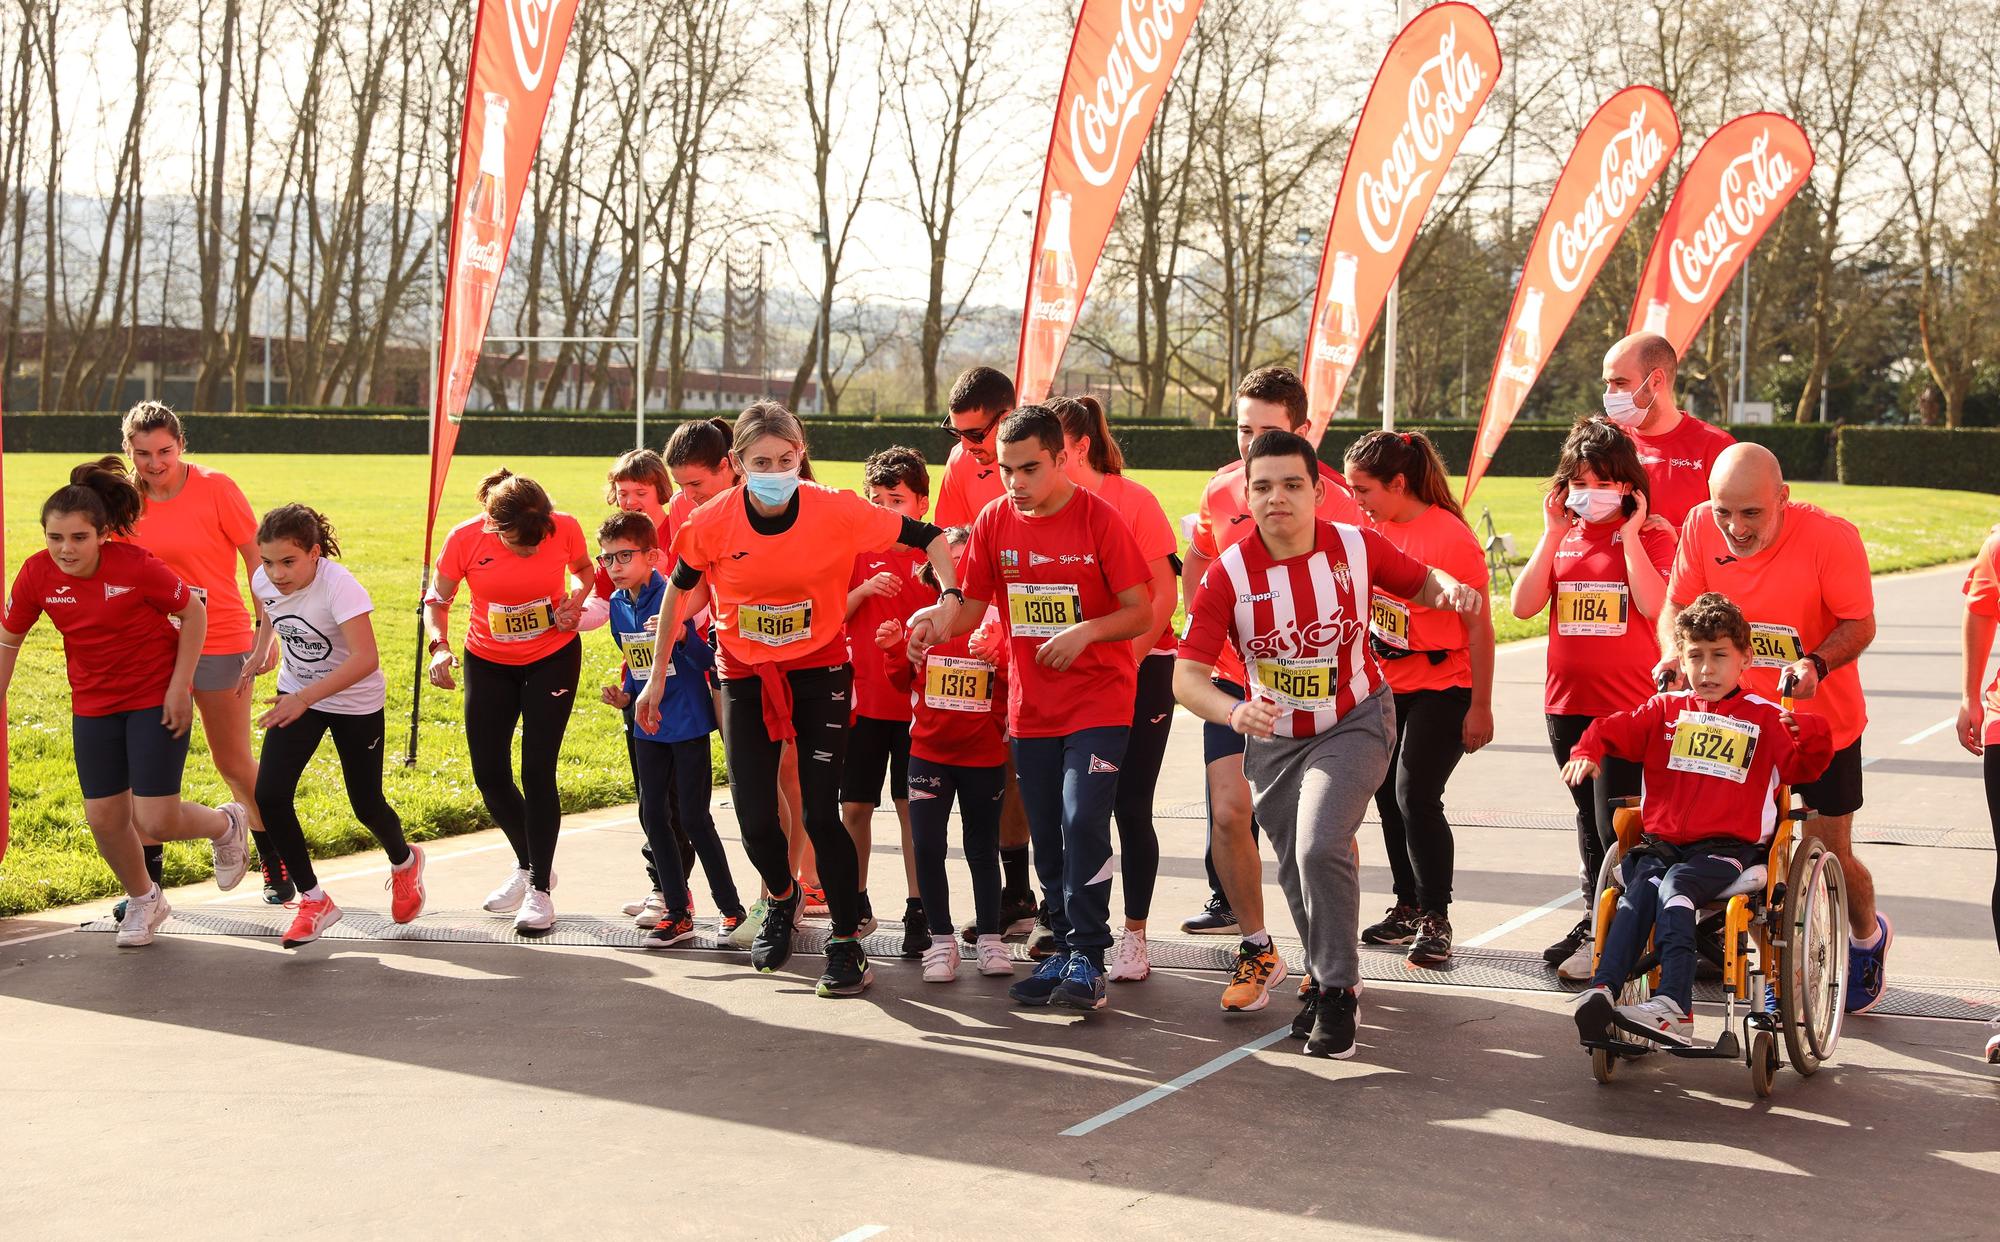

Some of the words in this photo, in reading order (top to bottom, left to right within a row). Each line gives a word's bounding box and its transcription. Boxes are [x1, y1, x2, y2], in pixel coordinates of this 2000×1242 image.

[1356, 20, 1482, 253] Coca-Cola
[1548, 100, 1663, 292] Coca-Cola
[1669, 128, 1792, 303] Coca-Cola
[46, 596, 76, 604] ABANCA
[1240, 591, 1279, 603] Kappa
[1024, 601, 1067, 623] 1308
[1372, 604, 1397, 632] 1319
[1573, 599, 1608, 621] 1184
[505, 613, 539, 633] 1315
[757, 617, 793, 635] 1316
[629, 647, 654, 668] 1311
[1751, 637, 1786, 658] 314
[1281, 668, 1311, 676] RODRIGO
[941, 674, 977, 698] 1313
[1273, 671, 1320, 698] 1305
[1706, 726, 1723, 735] XUNE
[1688, 731, 1735, 763] 1324
